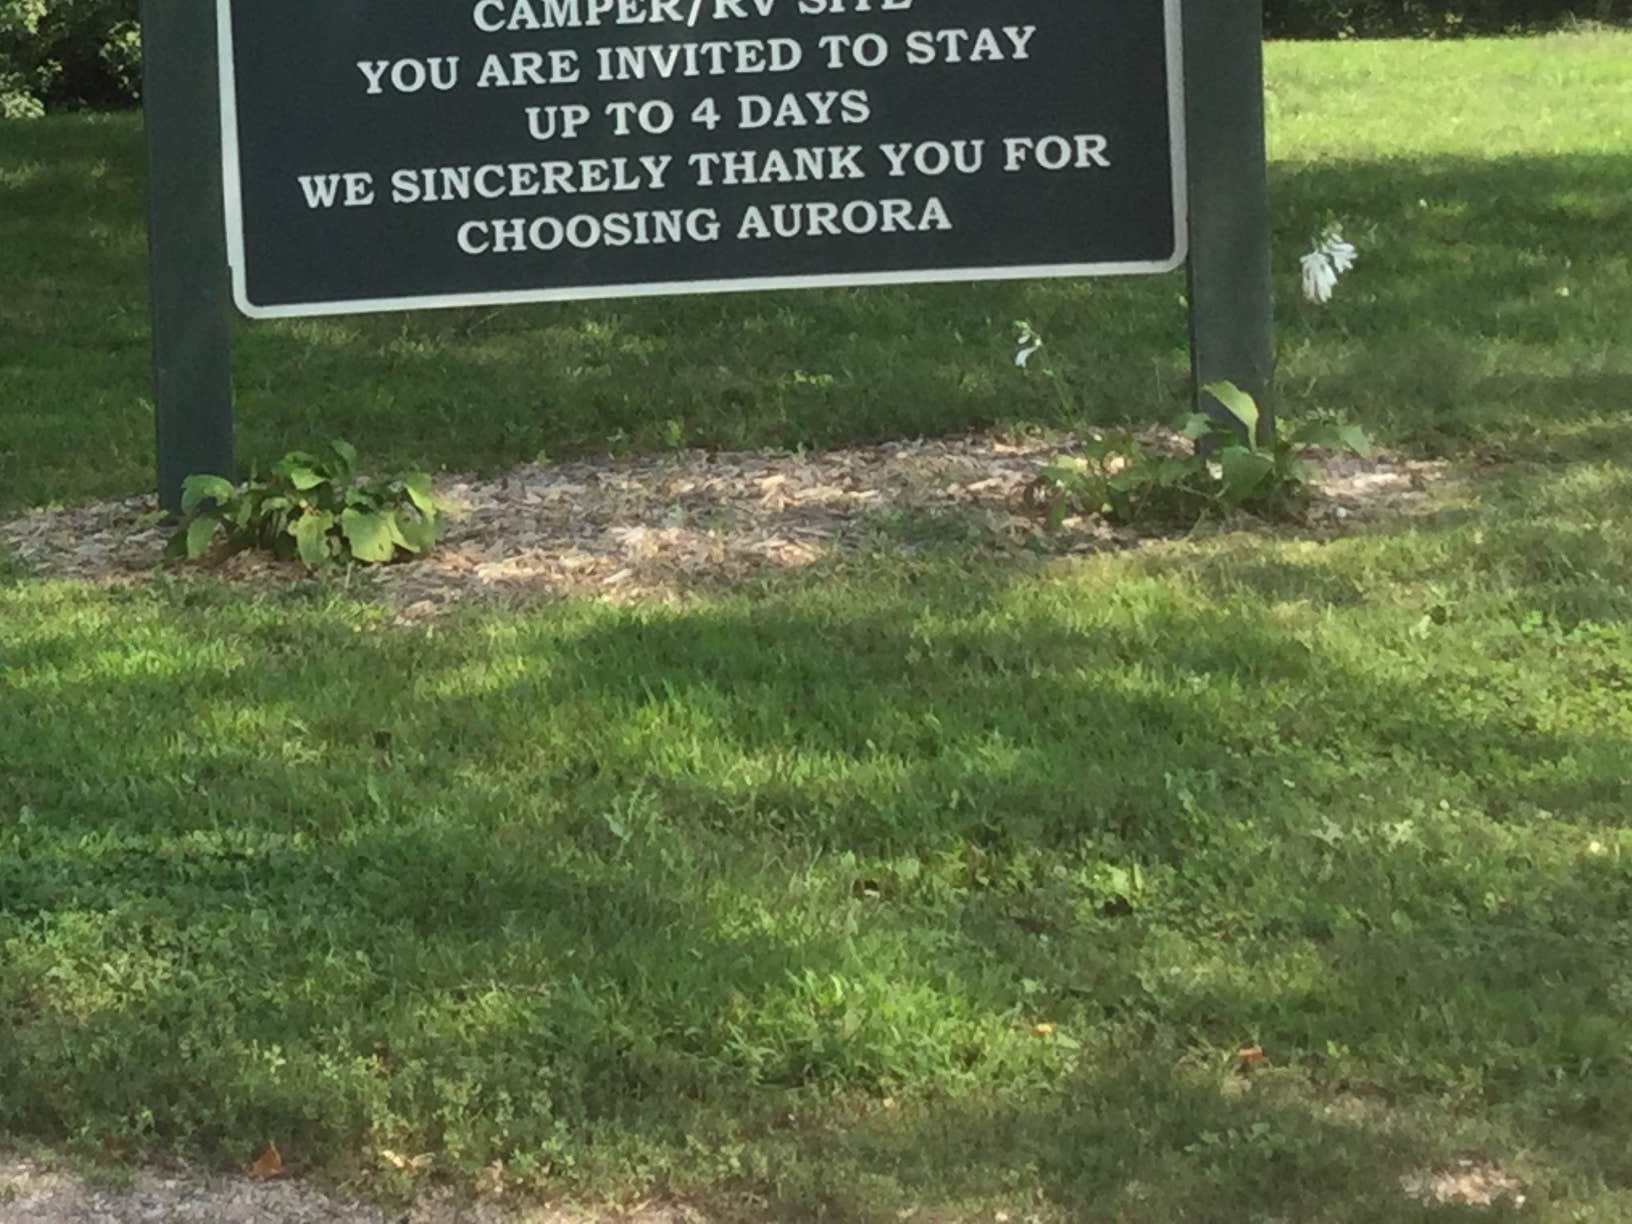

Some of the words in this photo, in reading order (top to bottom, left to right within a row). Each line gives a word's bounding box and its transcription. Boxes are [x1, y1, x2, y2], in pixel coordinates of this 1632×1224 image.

[357, 57, 459, 93] YOU
[477, 50, 579, 87] ARE
[597, 38, 801, 80] INVITED
[819, 33, 887, 68] TO
[906, 26, 1036, 64] STAY
[525, 105, 590, 139] UP
[605, 100, 674, 135] TO
[692, 98, 720, 129] 4
[738, 90, 870, 128] DAYS
[298, 173, 374, 208] WE
[392, 156, 672, 202] SINCERELY
[689, 146, 864, 185] THANK
[880, 140, 984, 176] YOU
[1003, 135, 1110, 170] FOR
[458, 208, 720, 253] CHOOSING
[737, 198, 952, 239] AURORA
